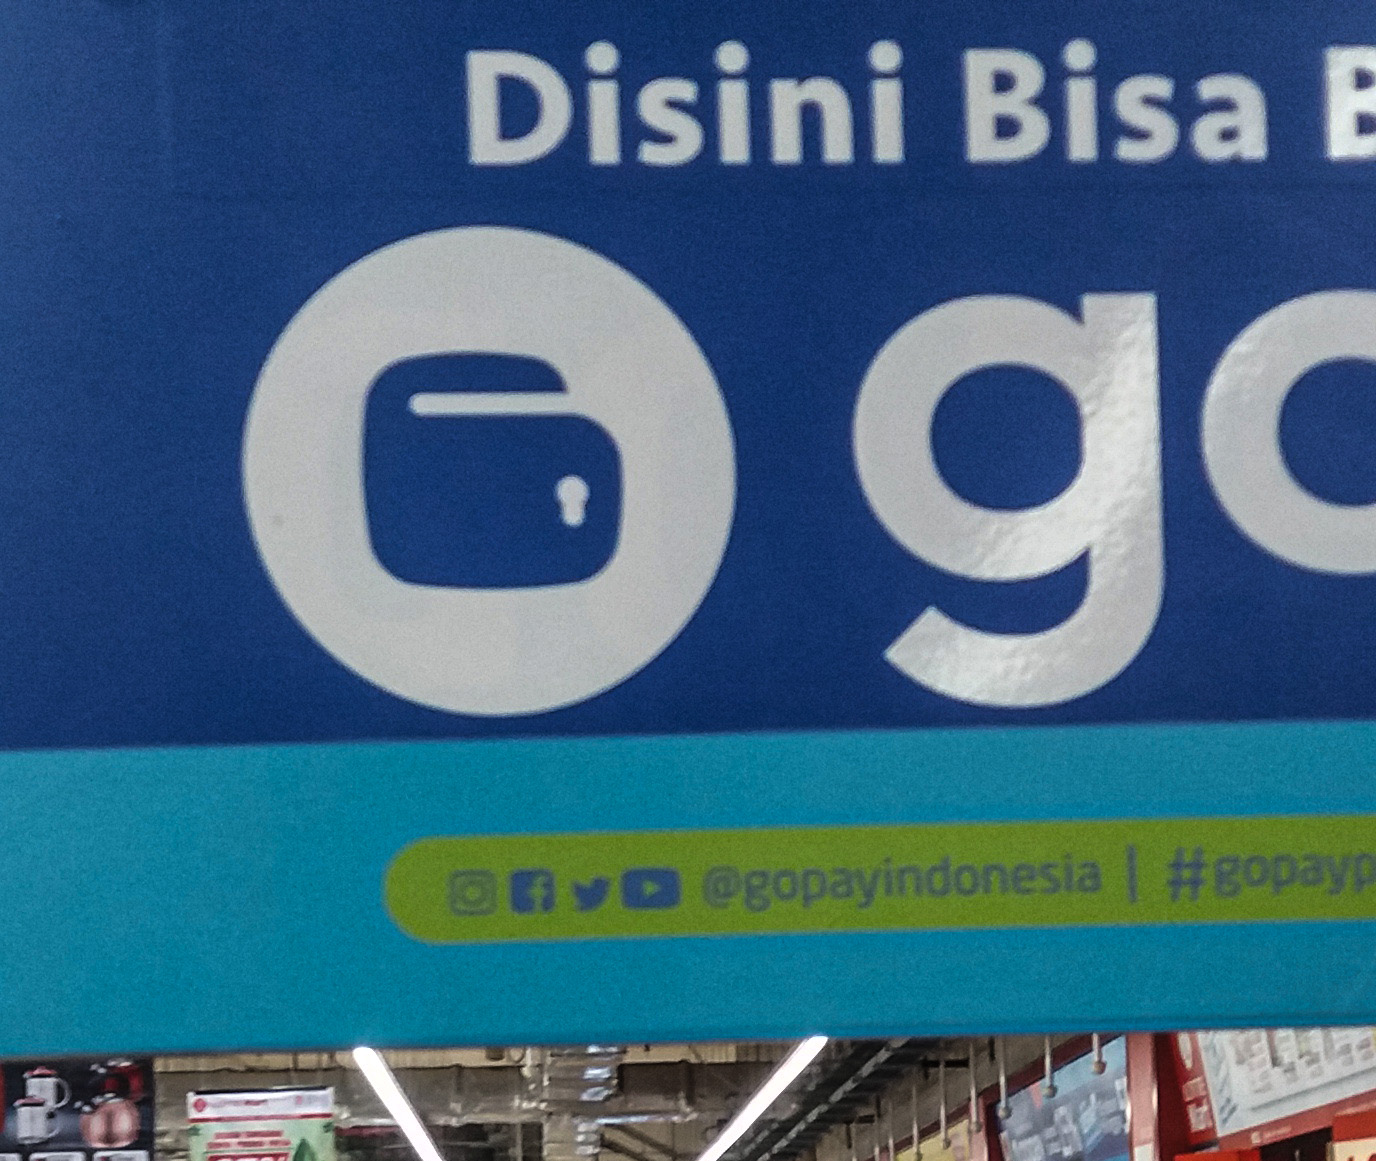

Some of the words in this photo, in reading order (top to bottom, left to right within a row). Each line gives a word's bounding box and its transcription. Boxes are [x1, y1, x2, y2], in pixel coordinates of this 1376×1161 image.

[468, 43, 902, 165] Disini
[966, 41, 1267, 162] Bisa
[703, 852, 1103, 912] @gopayindonesia
